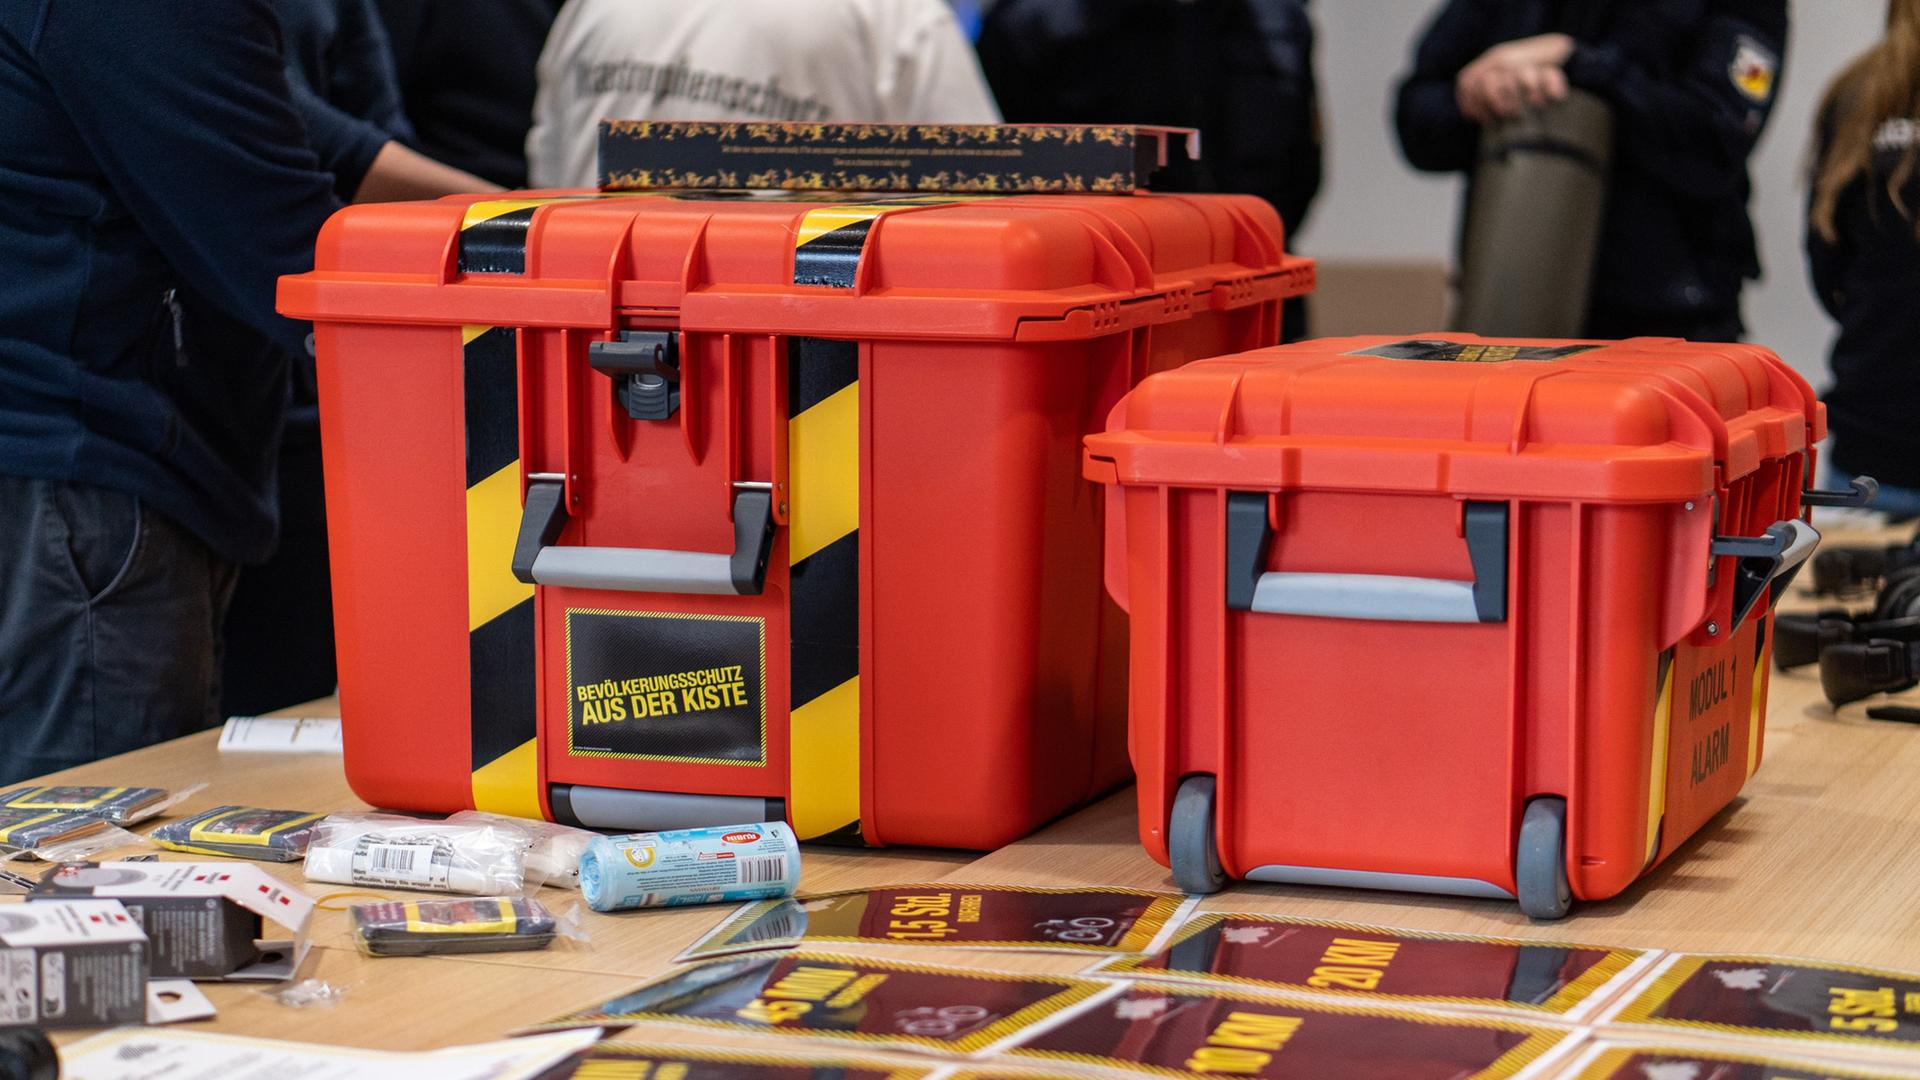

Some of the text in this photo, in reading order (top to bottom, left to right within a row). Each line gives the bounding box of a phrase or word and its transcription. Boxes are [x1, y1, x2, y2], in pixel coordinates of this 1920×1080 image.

[577, 665, 743, 702] BEVÖLKERUNGSSCHUTZ
[582, 681, 748, 726] AUS DER KISTE
[1689, 654, 1737, 722] MODUL 1
[1690, 722, 1730, 790] ALARM
[725, 832, 757, 842] RUBIN
[886, 893, 959, 939] 1,5 Std.
[1306, 937, 1402, 991] 20 KM
[1183, 1011, 1304, 1074] 10 KM
[1829, 1016, 1899, 1033] 5
